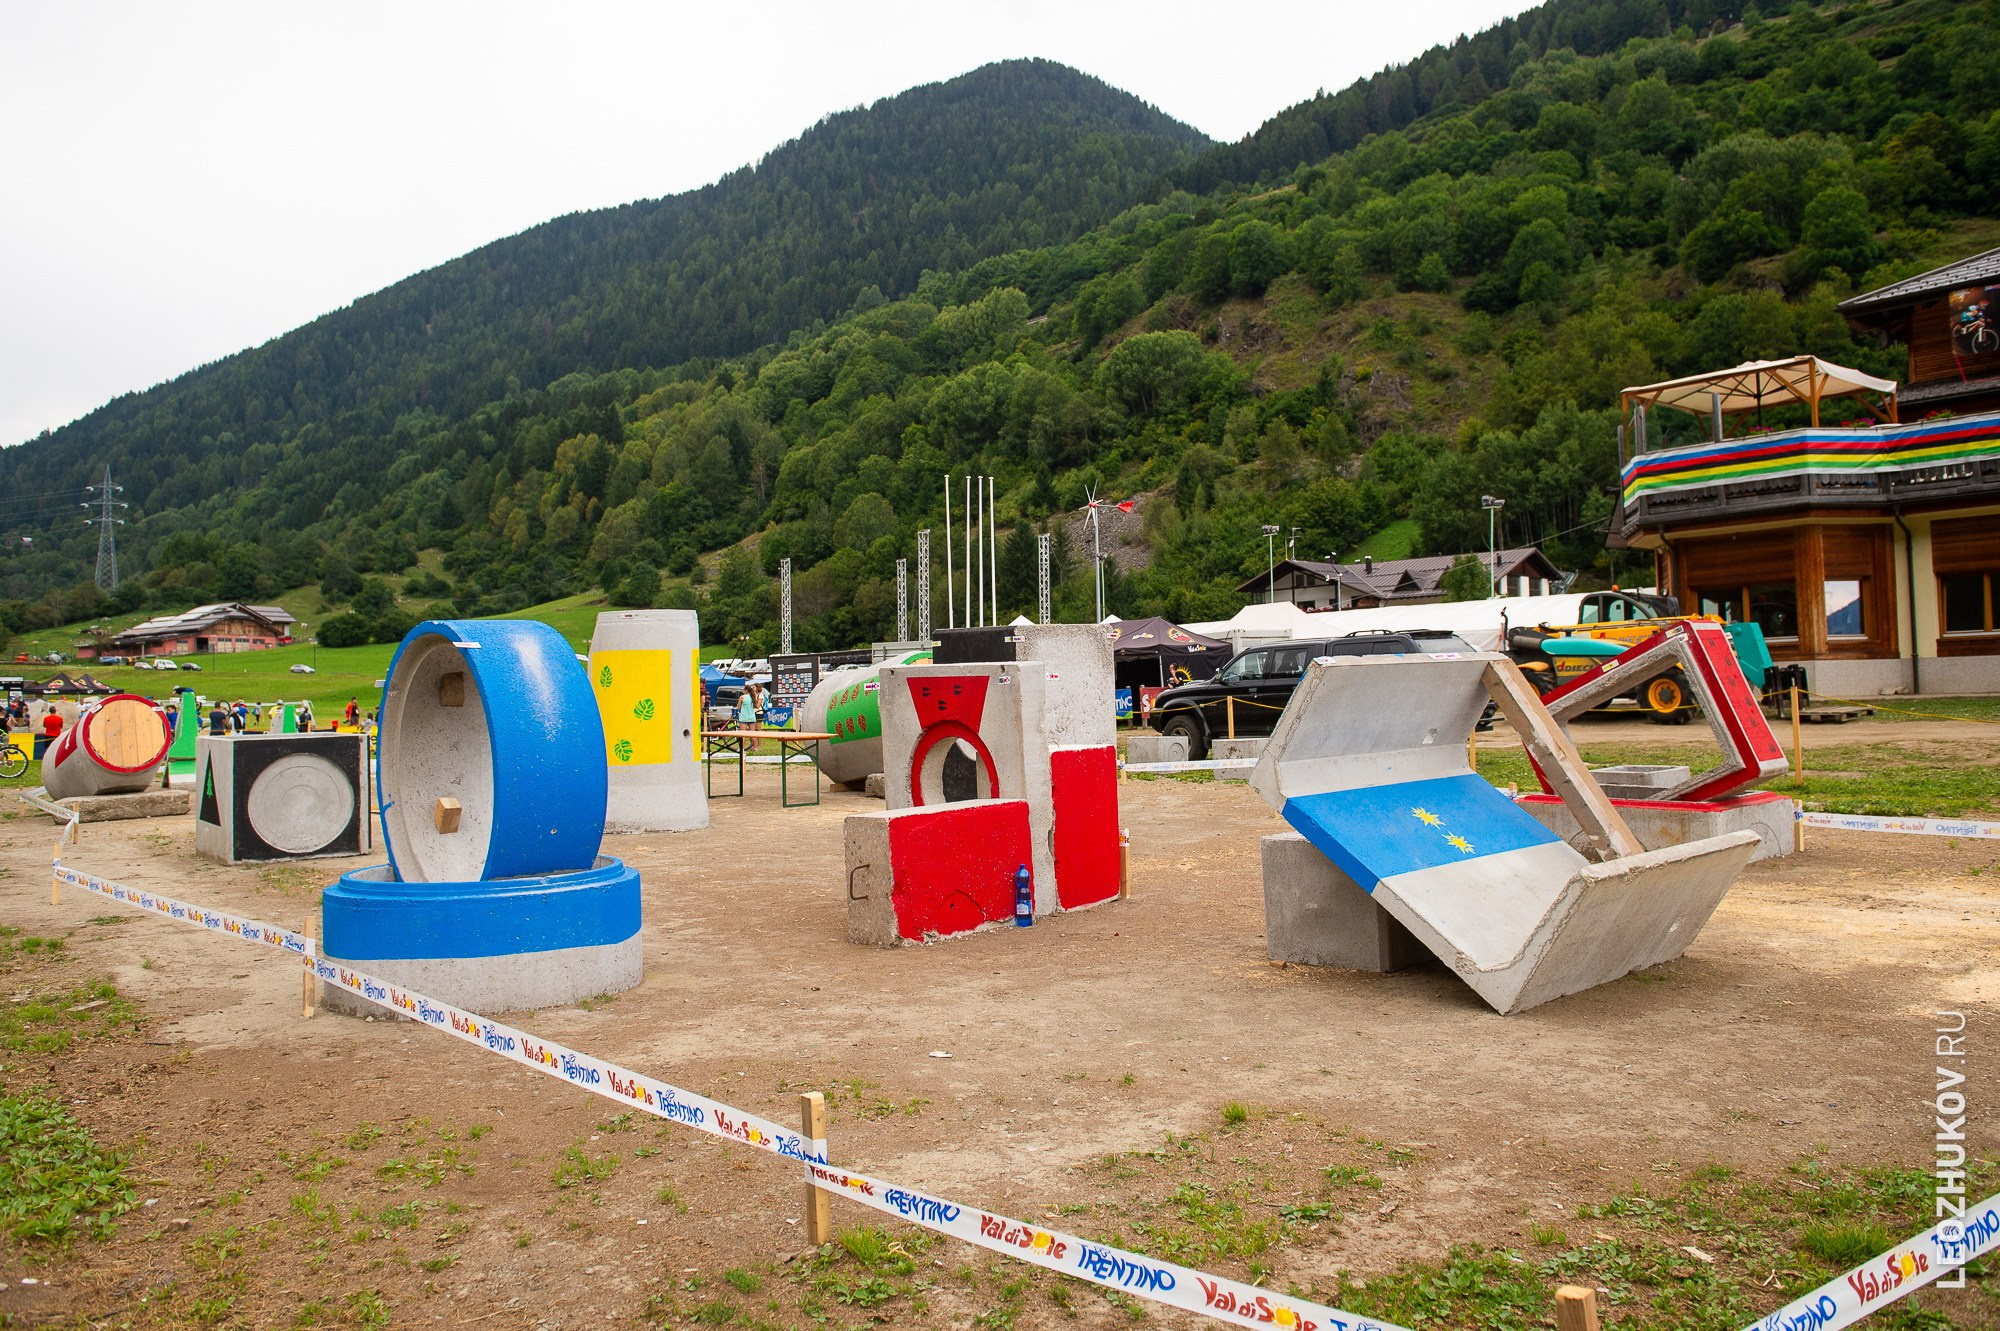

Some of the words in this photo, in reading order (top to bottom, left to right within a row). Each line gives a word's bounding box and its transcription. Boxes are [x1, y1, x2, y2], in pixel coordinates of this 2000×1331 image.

[417, 1000, 445, 1024] TRENTINO
[450, 1010, 460, 1030] Val
[465, 1017, 480, 1038] Sole
[482, 1025, 515, 1053] TRENTINO
[521, 1037, 534, 1058] Val
[539, 1045, 558, 1069] Sole
[560, 1055, 600, 1085] TRENTINO
[607, 1070, 623, 1094] Val
[624, 1084, 631, 1096] di
[630, 1079, 654, 1106] Sole
[656, 1090, 704, 1126] TRENTINO
[714, 1109, 734, 1136] Val
[741, 1121, 771, 1148] Sole
[884, 1188, 961, 1225] TRENTINO
[980, 1213, 1004, 1241] Val
[1004, 1228, 1020, 1246] di
[1018, 1225, 1068, 1260] Sole
[1077, 1243, 1176, 1293] TRENTINO
[1195, 1276, 1237, 1313] Val
[1238, 1301, 1257, 1319] di
[1255, 1296, 1318, 1331] Sole
[1886, 1249, 1929, 1288] Sole
[1847, 1268, 1880, 1307] Val
[1881, 1270, 1894, 1294] di
